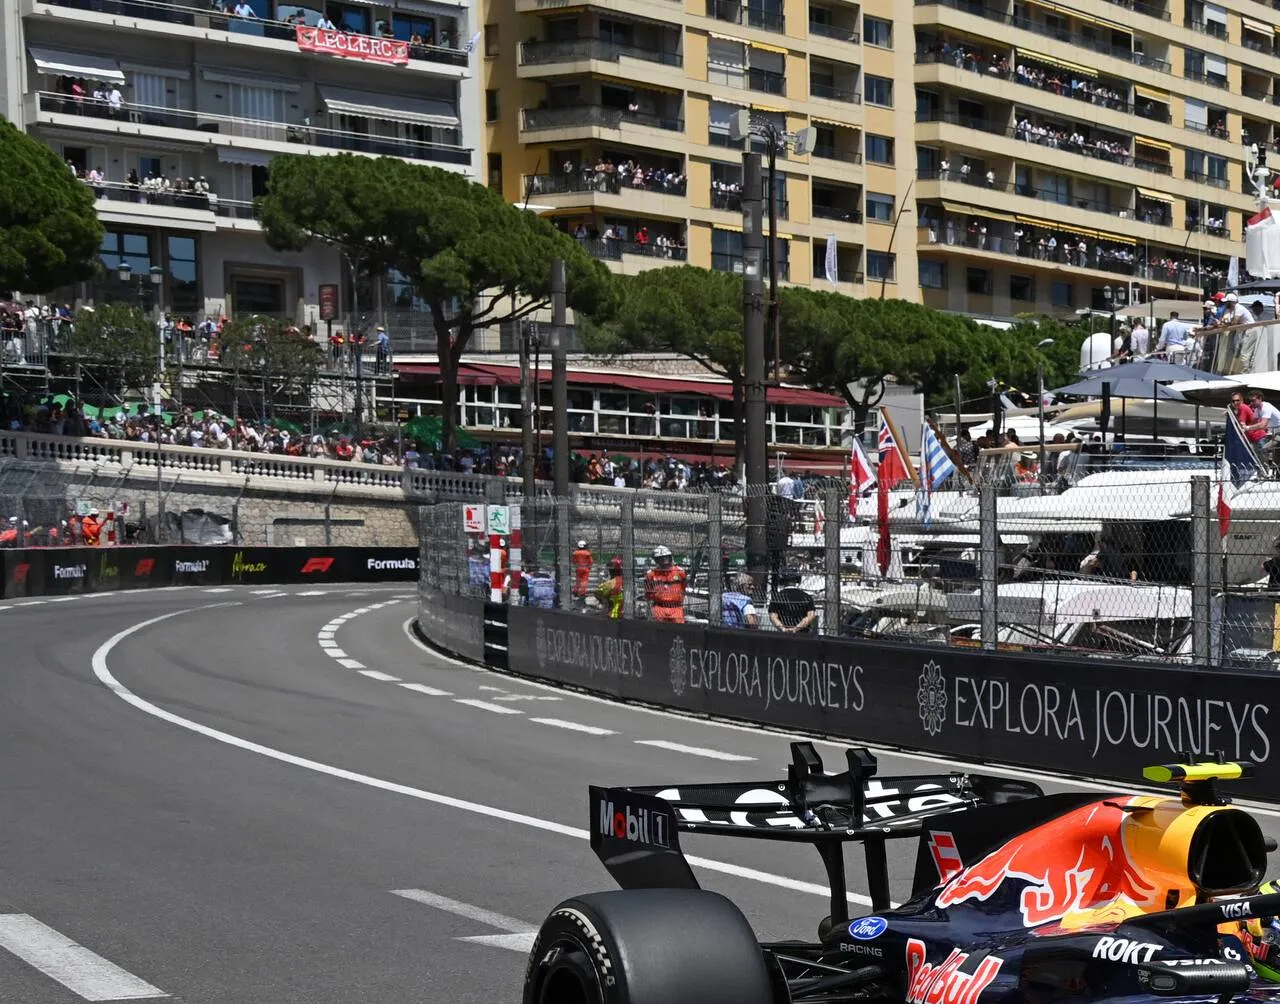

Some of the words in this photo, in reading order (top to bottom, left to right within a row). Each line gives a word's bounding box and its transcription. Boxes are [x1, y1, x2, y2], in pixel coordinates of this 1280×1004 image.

[314, 30, 392, 56] LECLERC
[367, 559, 416, 569] Formula
[689, 649, 762, 698] EXPLORA
[764, 656, 864, 712] JOURNEYS
[955, 677, 1085, 741] EXPLORA
[1092, 689, 1271, 763] JOURNEYS
[601, 799, 650, 844] Mobil
[655, 814, 667, 840] 1
[1220, 901, 1251, 919] VISA
[855, 921, 879, 937] Ford
[839, 942, 883, 957] RACING
[1092, 936, 1163, 964] ROKT
